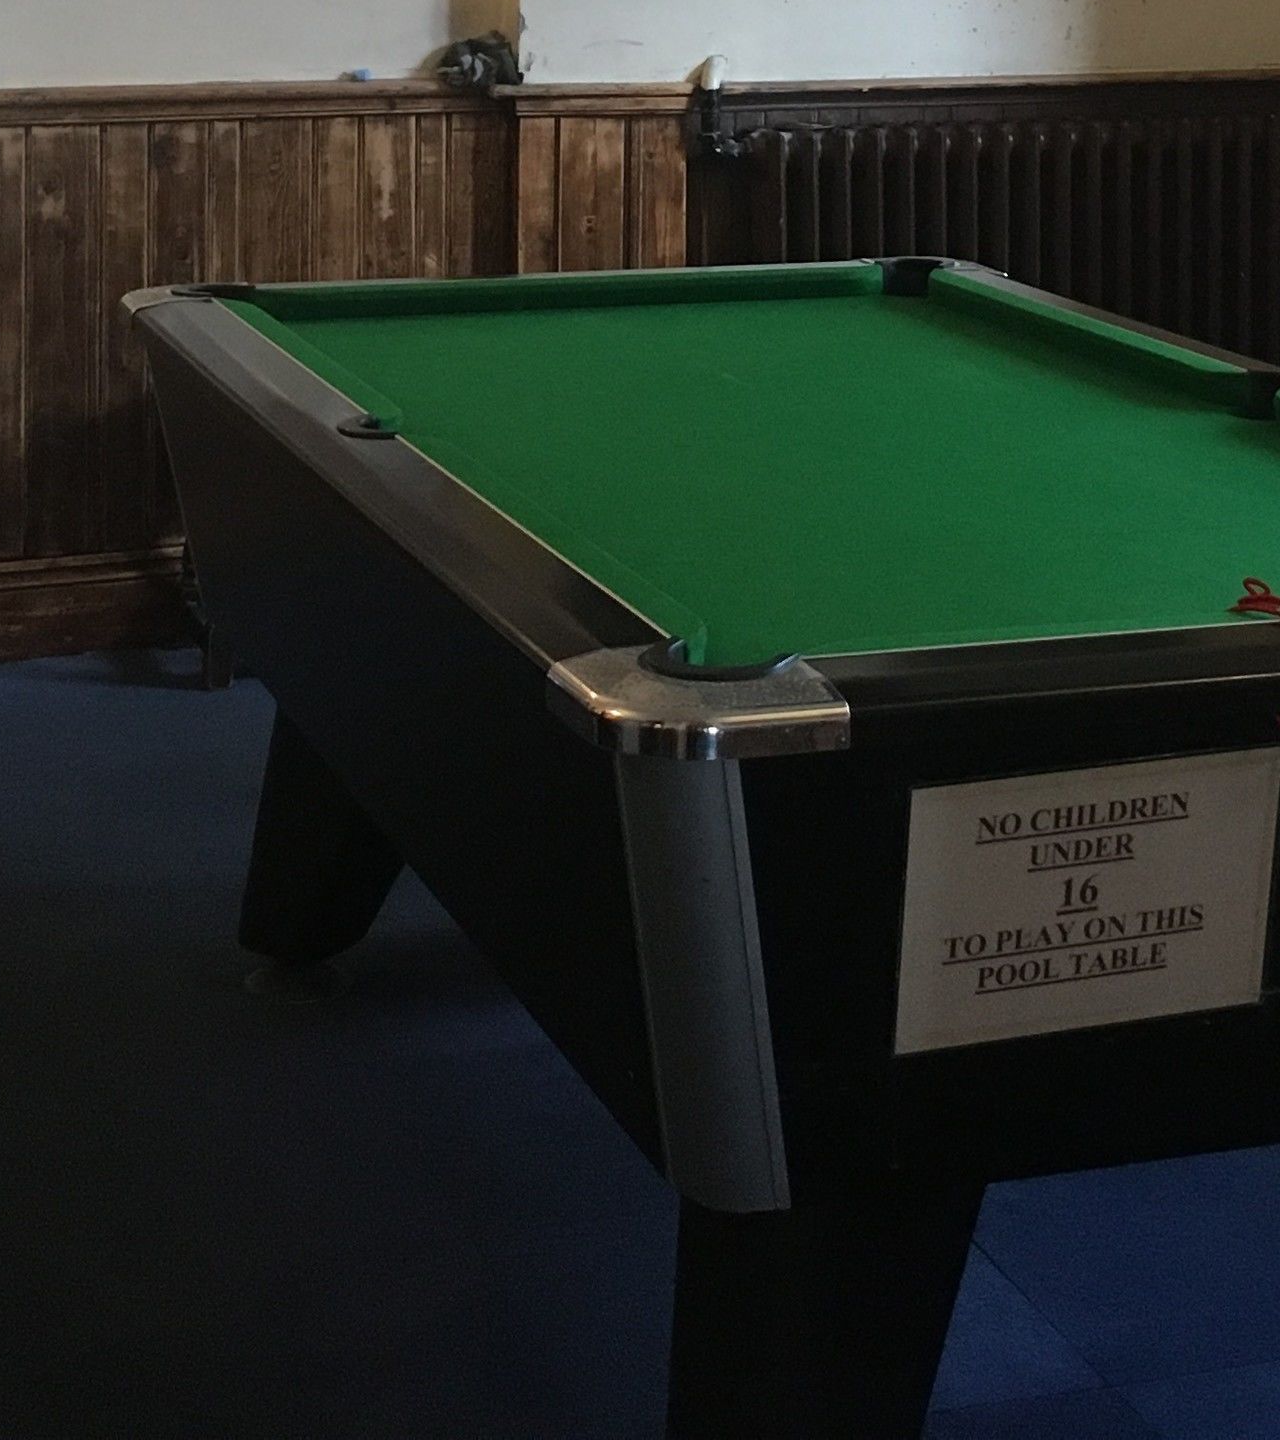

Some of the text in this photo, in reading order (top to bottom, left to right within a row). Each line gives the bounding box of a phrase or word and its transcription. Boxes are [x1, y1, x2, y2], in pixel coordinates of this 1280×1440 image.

[977, 792, 1189, 839] NO CHILDREN
[1030, 832, 1134, 867] UNDER
[1060, 874, 1098, 908] 16
[944, 903, 1204, 959] TO PLAY ON THIS
[977, 941, 1167, 989] POOL TABLE
